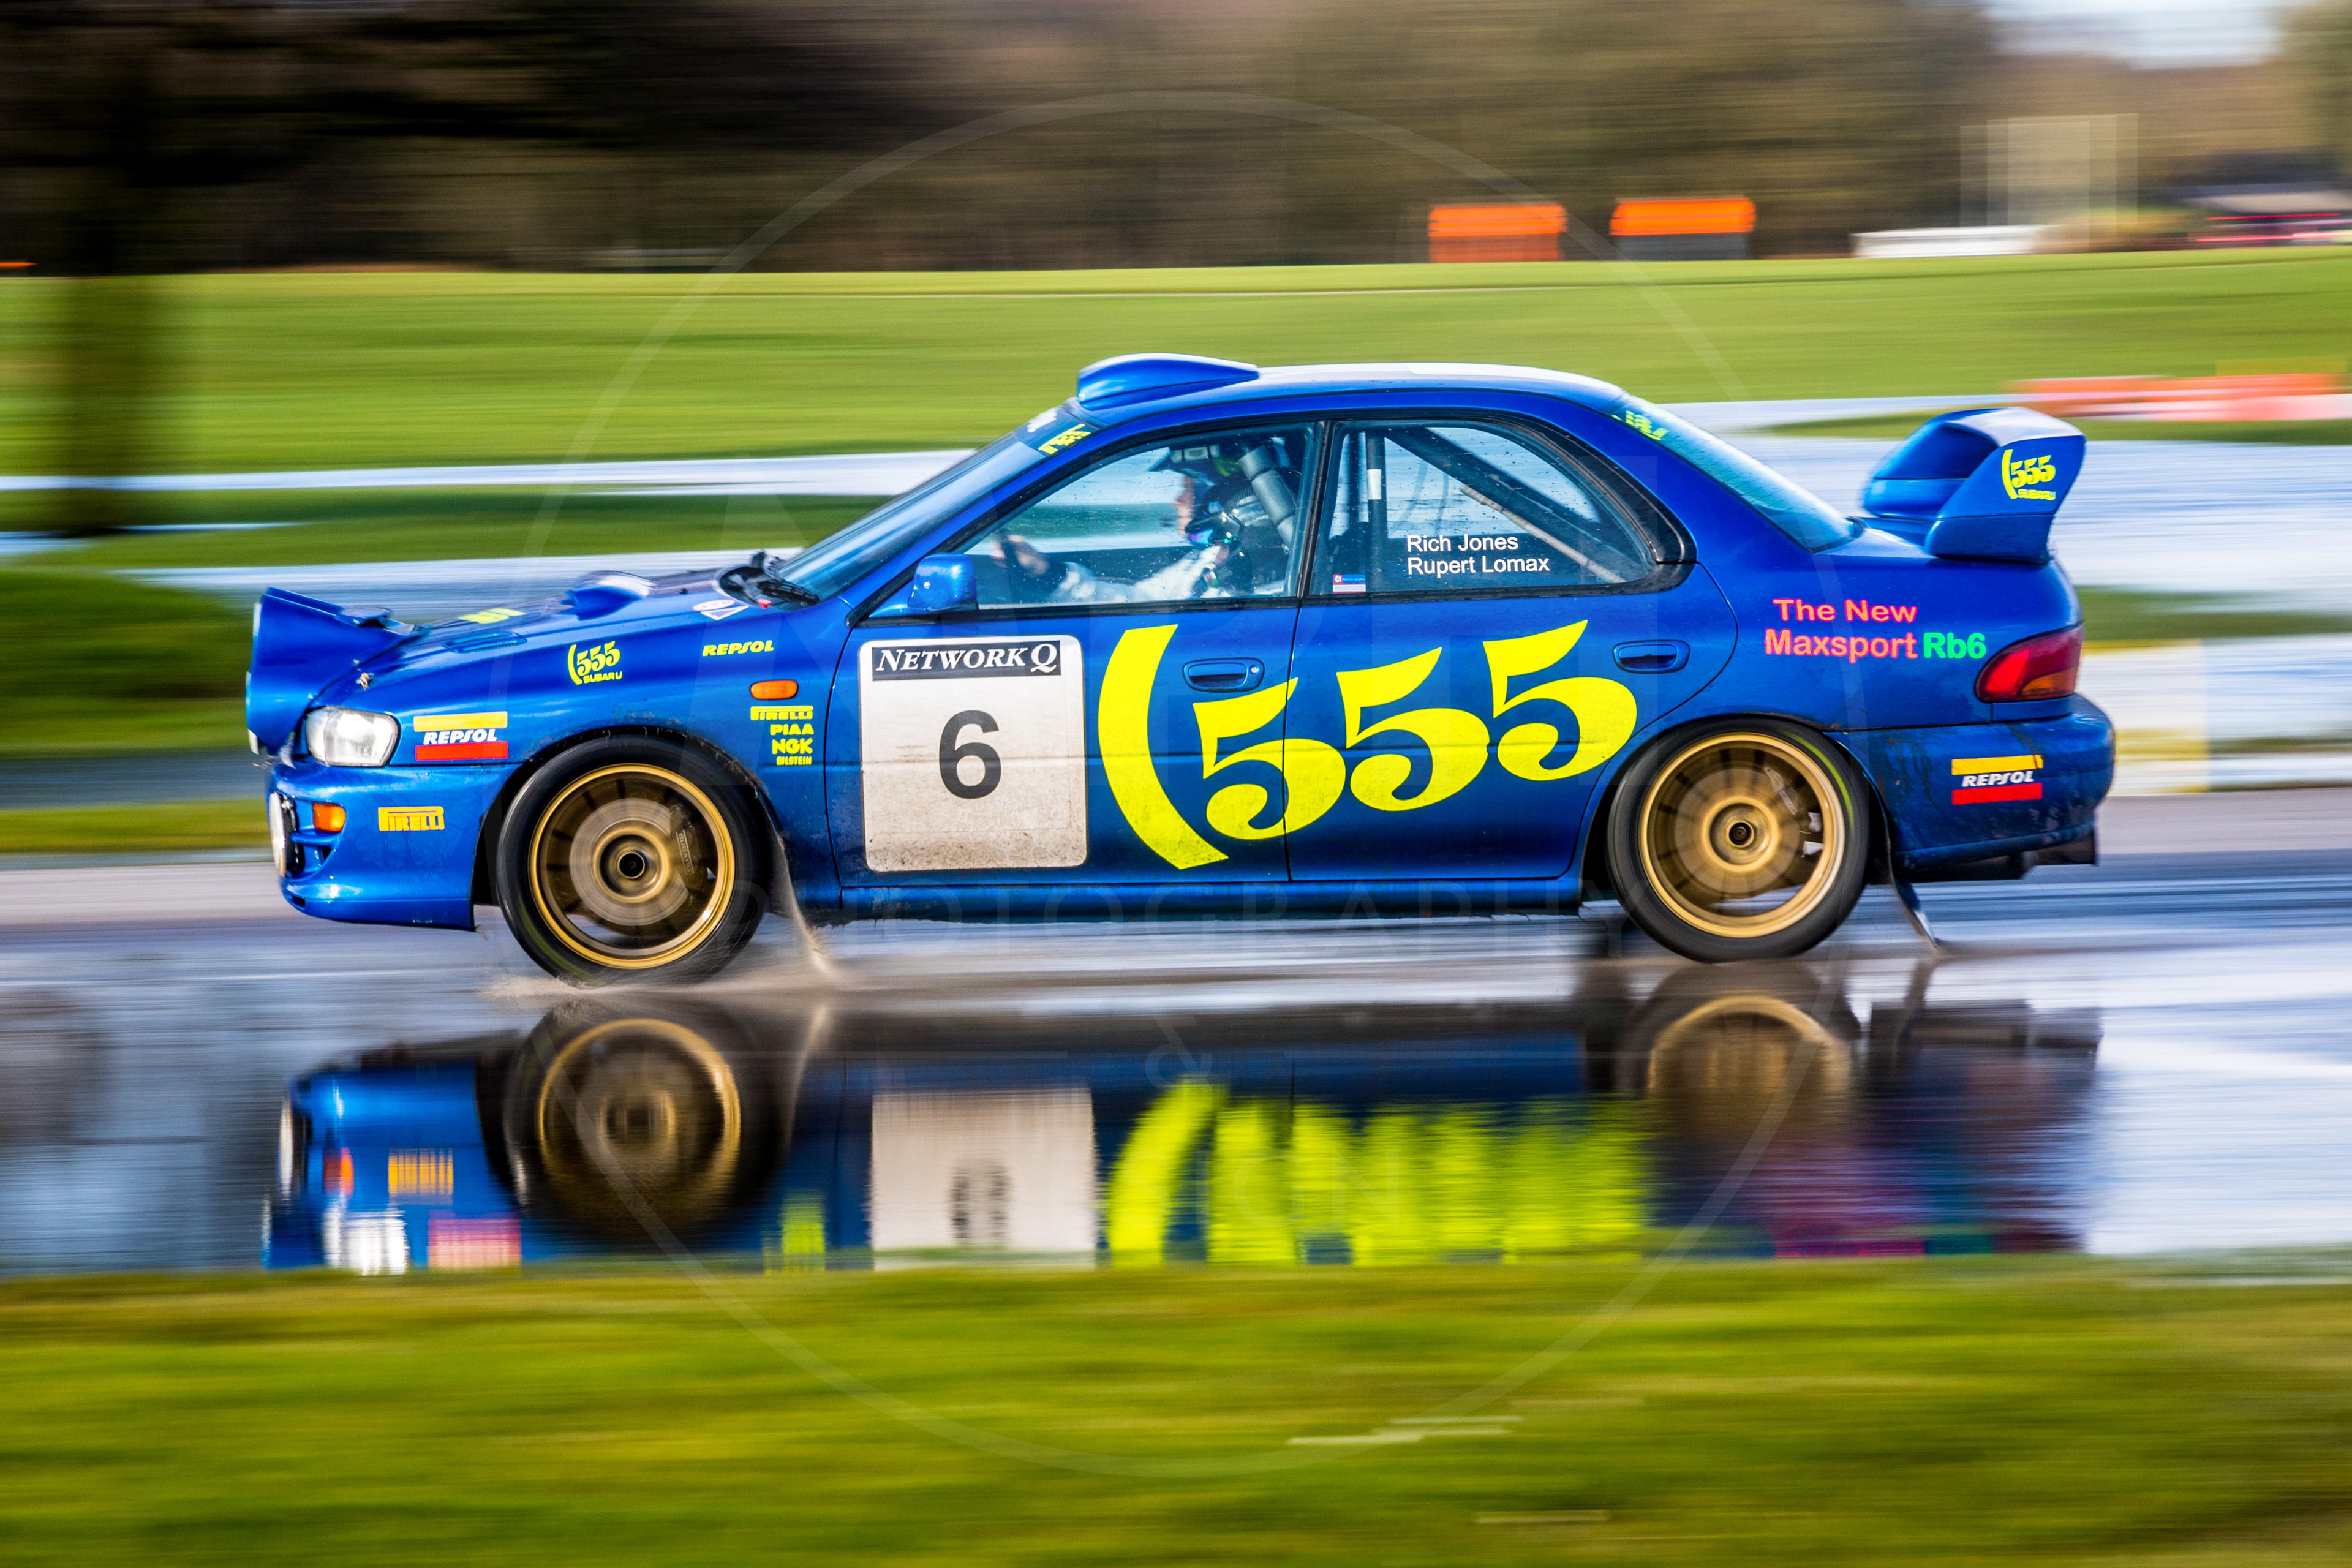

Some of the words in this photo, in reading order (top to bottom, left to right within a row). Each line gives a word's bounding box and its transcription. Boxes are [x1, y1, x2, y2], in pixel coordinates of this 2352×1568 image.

[1408, 534, 1451, 552] Rich
[1457, 533, 1519, 551] Jones
[1408, 556, 1476, 579] Rupert
[1482, 555, 1550, 573] Lomax
[1773, 598, 1836, 622] The
[1844, 598, 1918, 623] New
[702, 640, 774, 657] REPSOL
[1764, 628, 1919, 664] Maxsport
[1923, 631, 1987, 660] Rb6
[875, 647, 1028, 672] NETWORK
[1030, 644, 1058, 673] Q
[582, 671, 623, 684] SUBARU
[750, 705, 813, 721] PIRELLI
[423, 729, 498, 745] REPSOL
[770, 723, 815, 736] PIAA
[772, 737, 813, 755] NGK
[939, 710, 1002, 800] 6
[776, 756, 813, 766] BILSTEIN
[1961, 770, 2035, 788] REPSOL
[378, 806, 445, 832] PIRELLI
[679, 832, 692, 872] SUBARU
